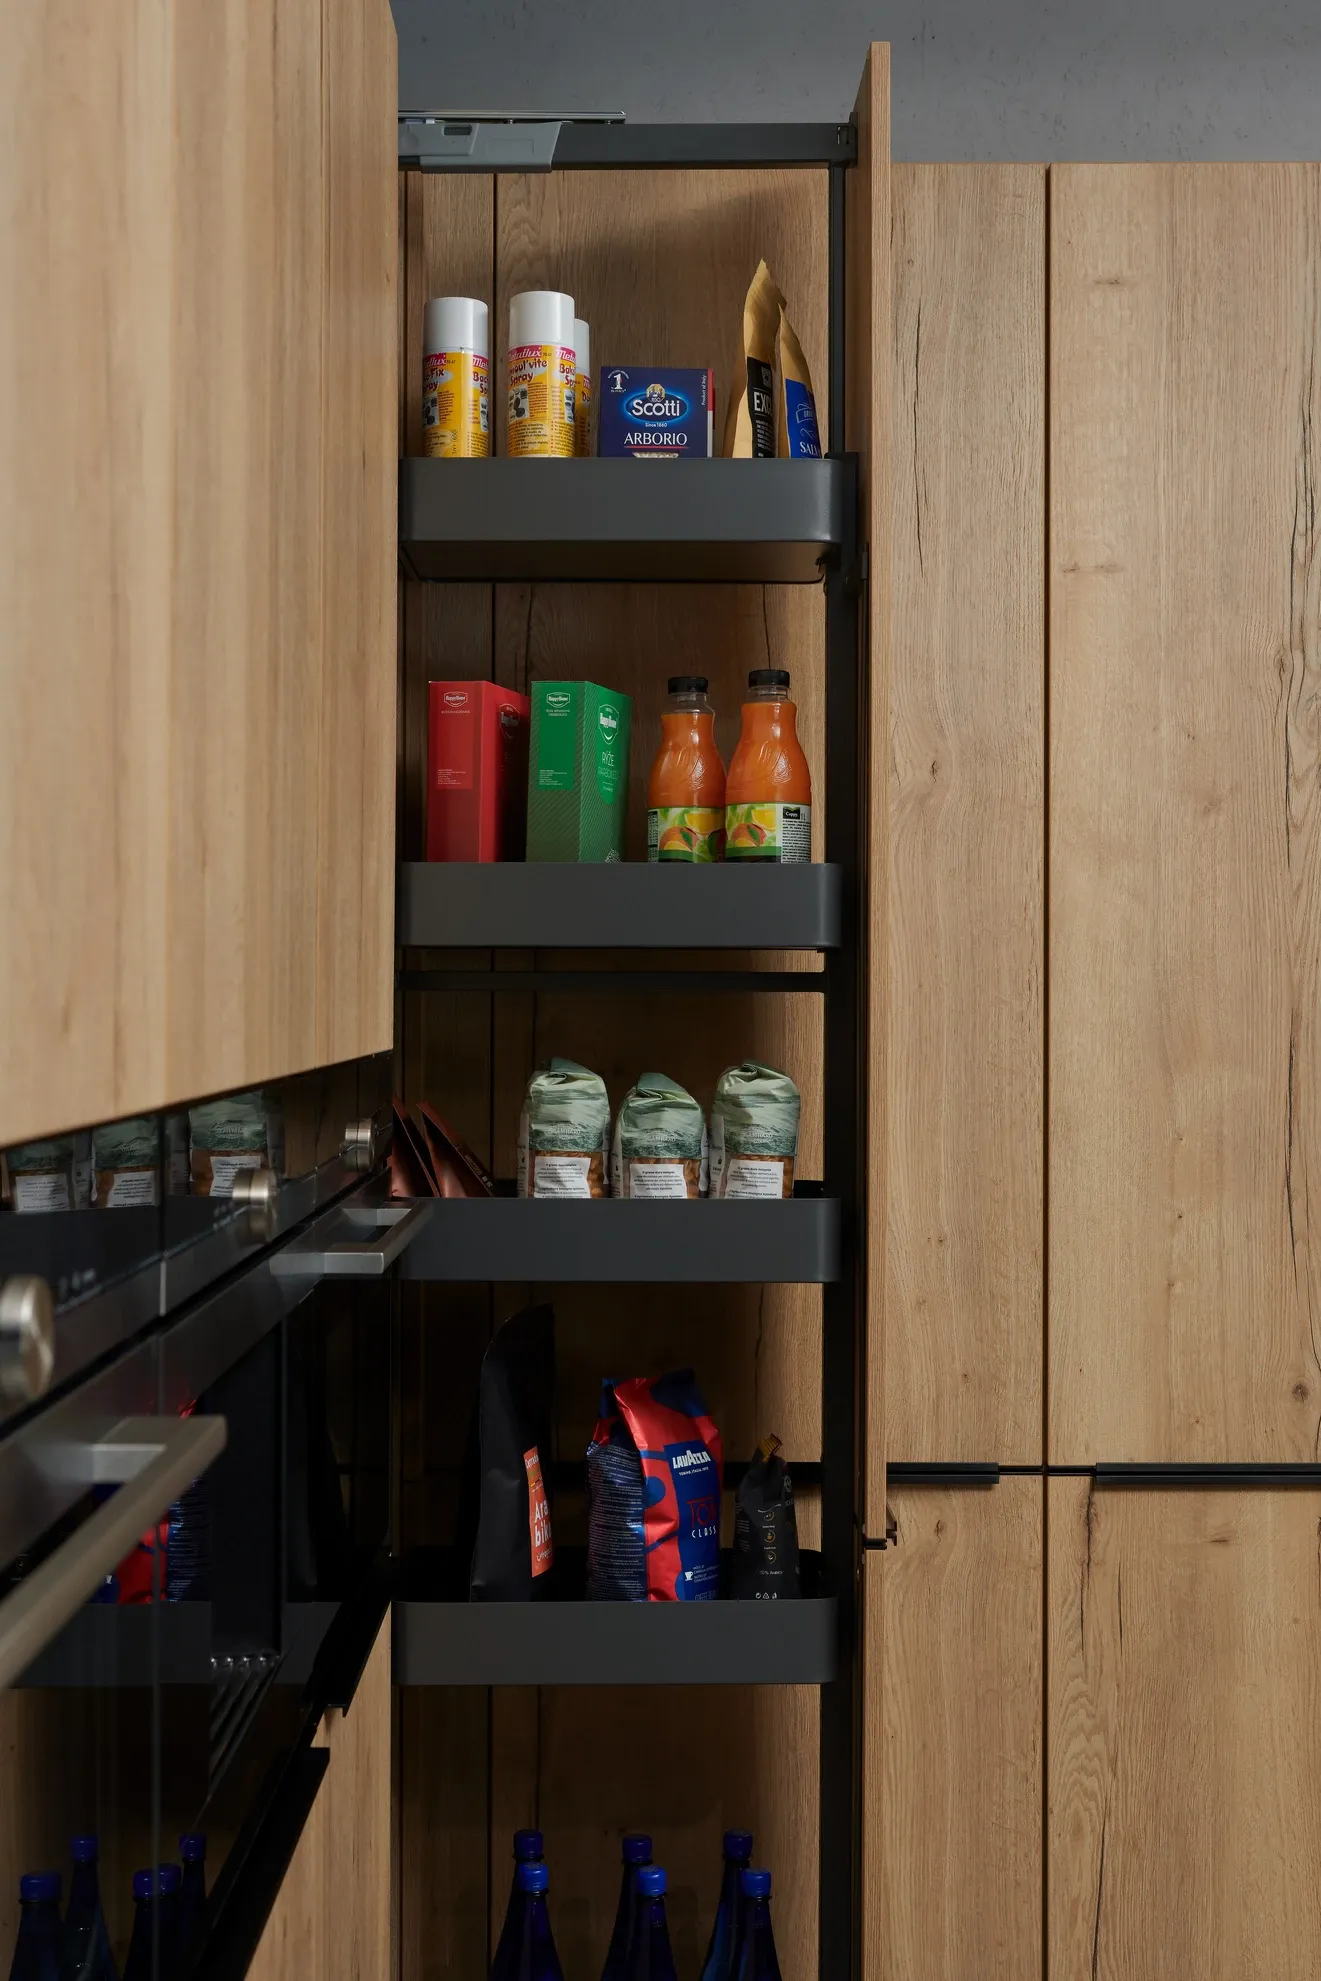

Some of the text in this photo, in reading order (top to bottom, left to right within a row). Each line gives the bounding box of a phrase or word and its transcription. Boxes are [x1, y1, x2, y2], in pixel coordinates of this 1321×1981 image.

[632, 399, 680, 416] Scotti
[624, 432, 688, 445] ARBORIO
[672, 1449, 712, 1470] LAVAZZA
[534, 1499, 549, 1524] Ara
[691, 1525, 717, 1539] CLASS
